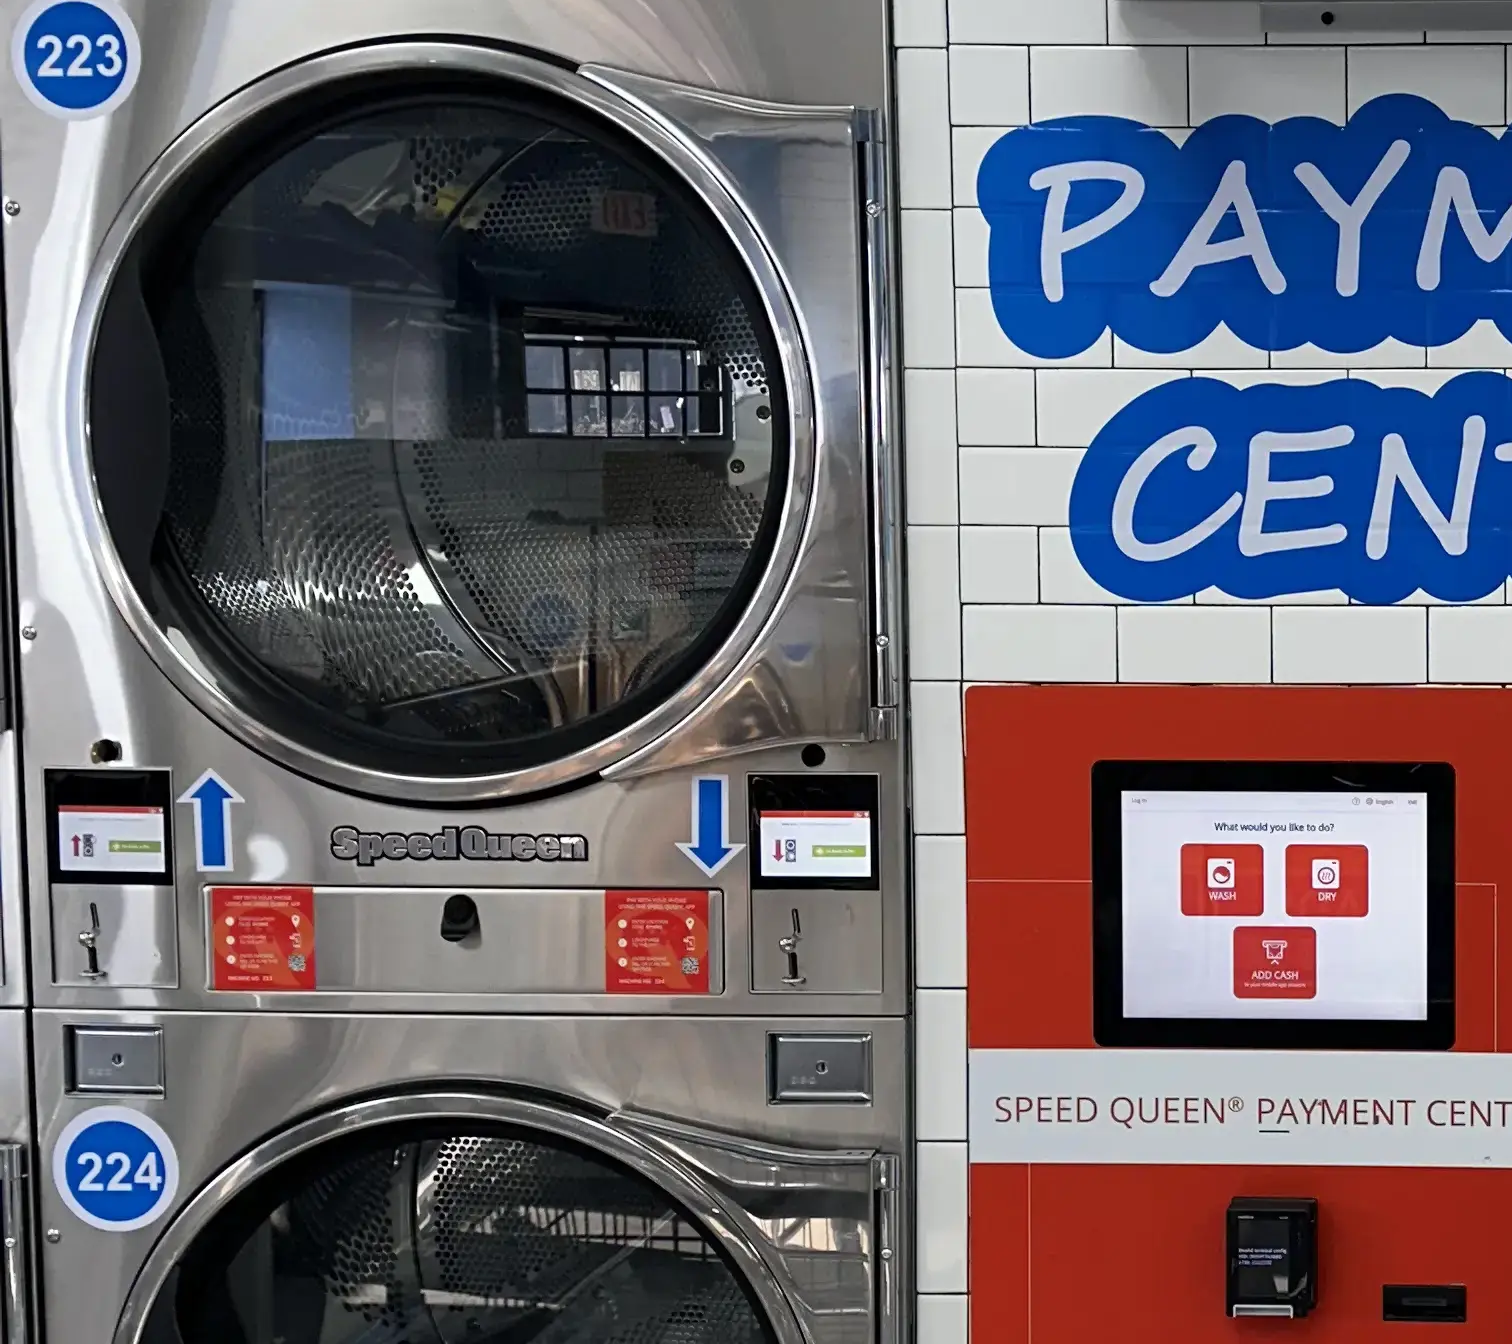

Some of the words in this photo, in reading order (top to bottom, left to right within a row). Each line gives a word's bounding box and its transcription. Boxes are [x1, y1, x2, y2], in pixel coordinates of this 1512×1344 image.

[37, 34, 122, 77] 223
[1214, 822, 1239, 832] What
[1240, 822, 1268, 832] would
[1269, 824, 1287, 834] you
[1288, 823, 1305, 832] like
[1306, 824, 1317, 832] to
[1318, 823, 1335, 832] do?
[331, 826, 460, 866] Speed
[460, 826, 588, 862] Queen
[1208, 891, 1237, 901] WASH
[1317, 892, 1337, 902] DRY
[1251, 970, 1273, 980] ADD
[1273, 970, 1299, 980] CASH
[994, 1096, 1098, 1124] SPEED
[1257, 1098, 1416, 1126] PAYMENT
[77, 1152, 162, 1191] 224
